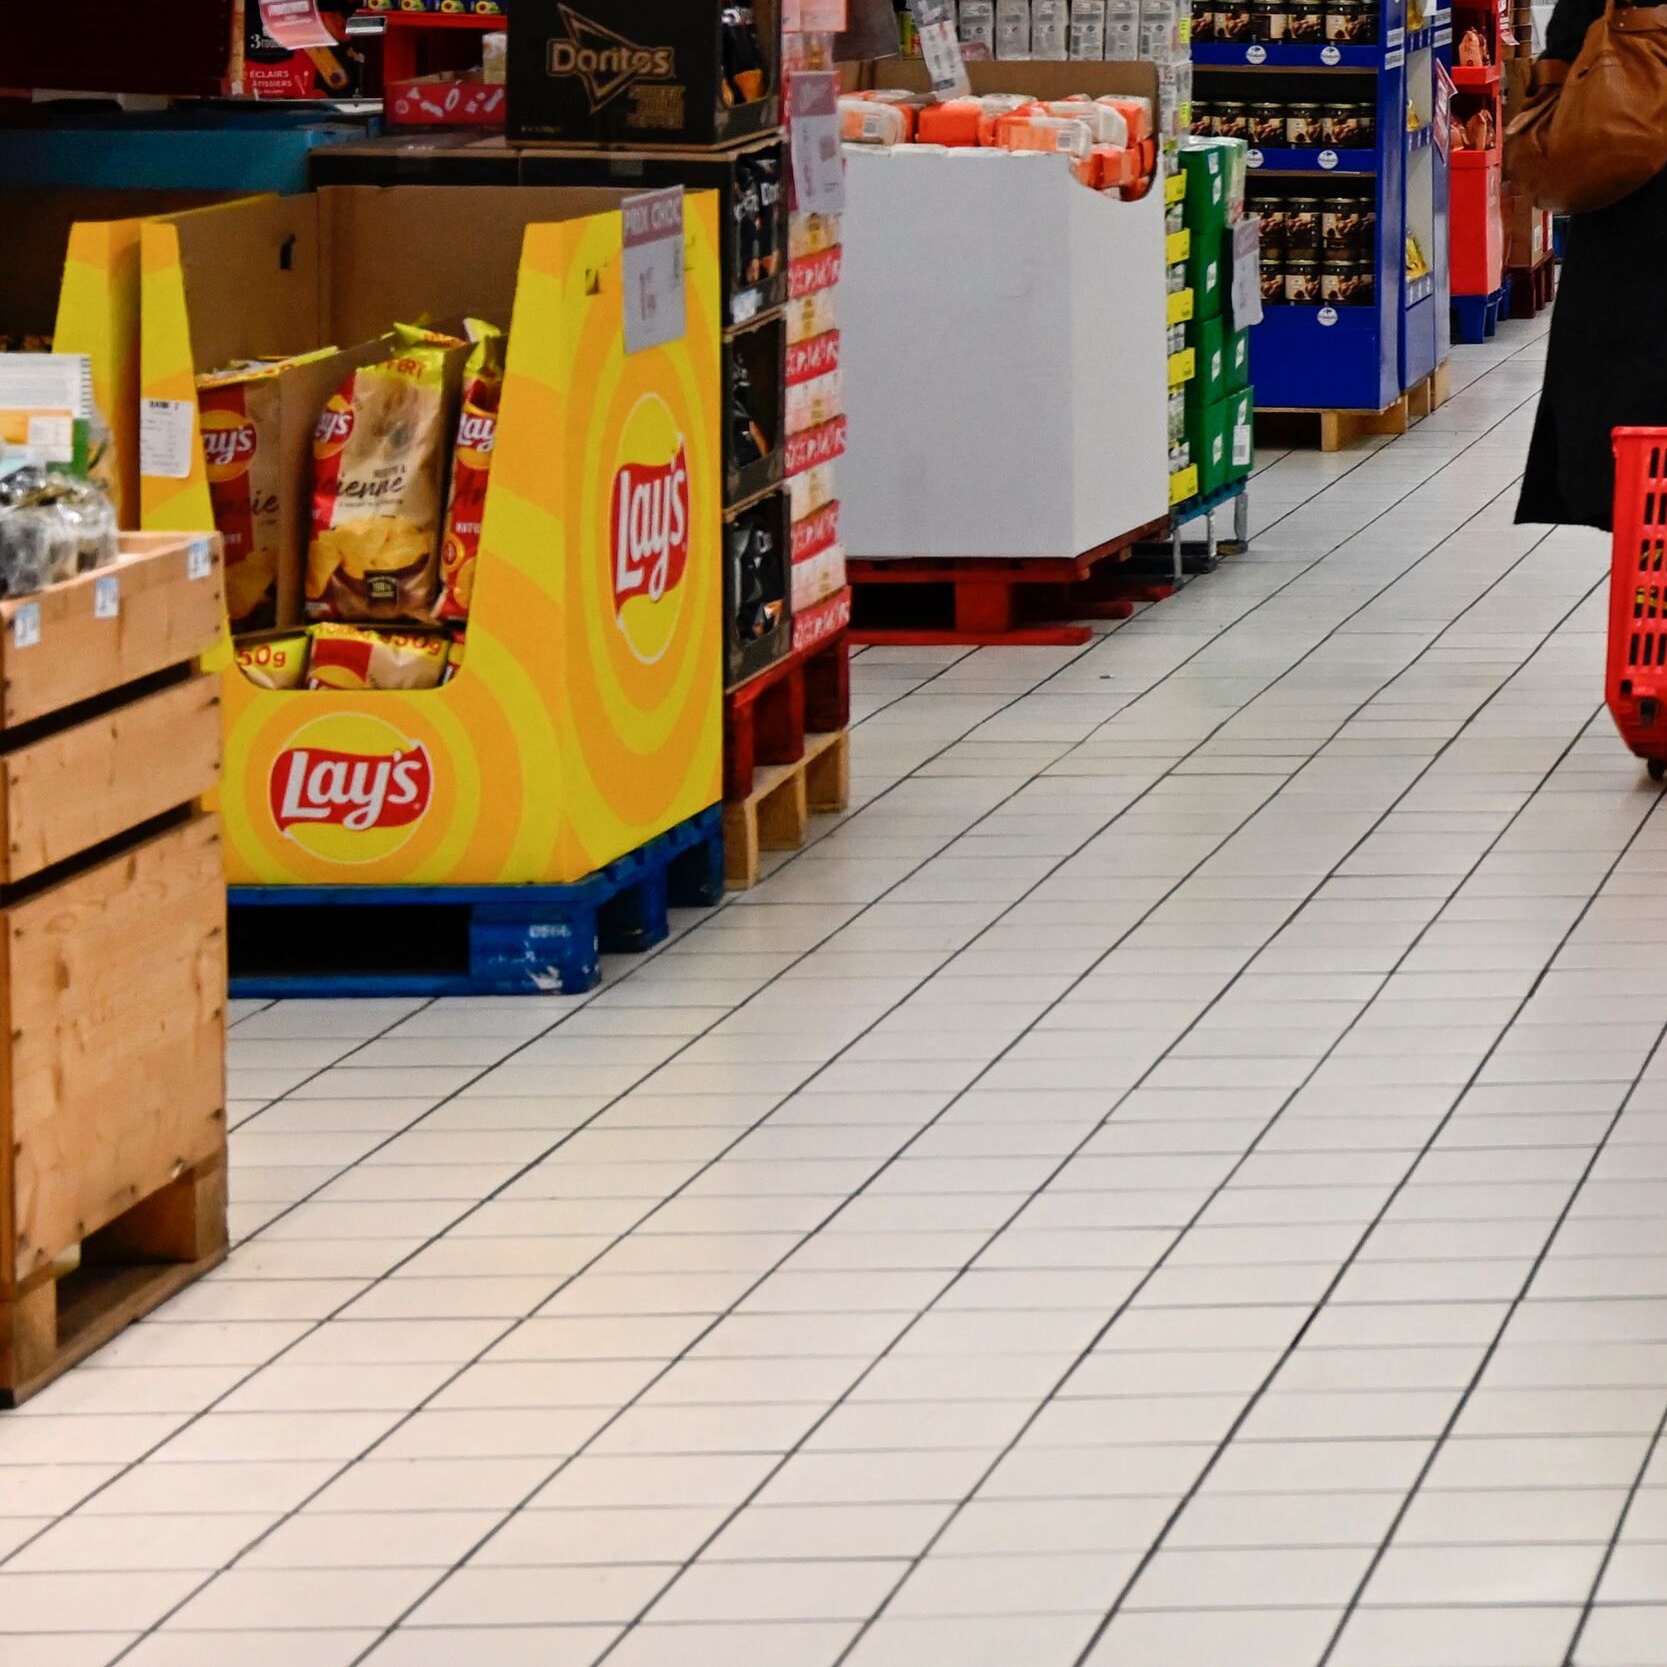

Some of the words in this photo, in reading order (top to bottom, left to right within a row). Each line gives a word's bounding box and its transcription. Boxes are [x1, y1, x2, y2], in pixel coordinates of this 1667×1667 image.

[552, 42, 671, 74] Doritos
[623, 204, 648, 234] PRIX
[652, 198, 683, 228] CHOC
[615, 452, 686, 603] Lay's
[279, 748, 421, 830] Lay's
